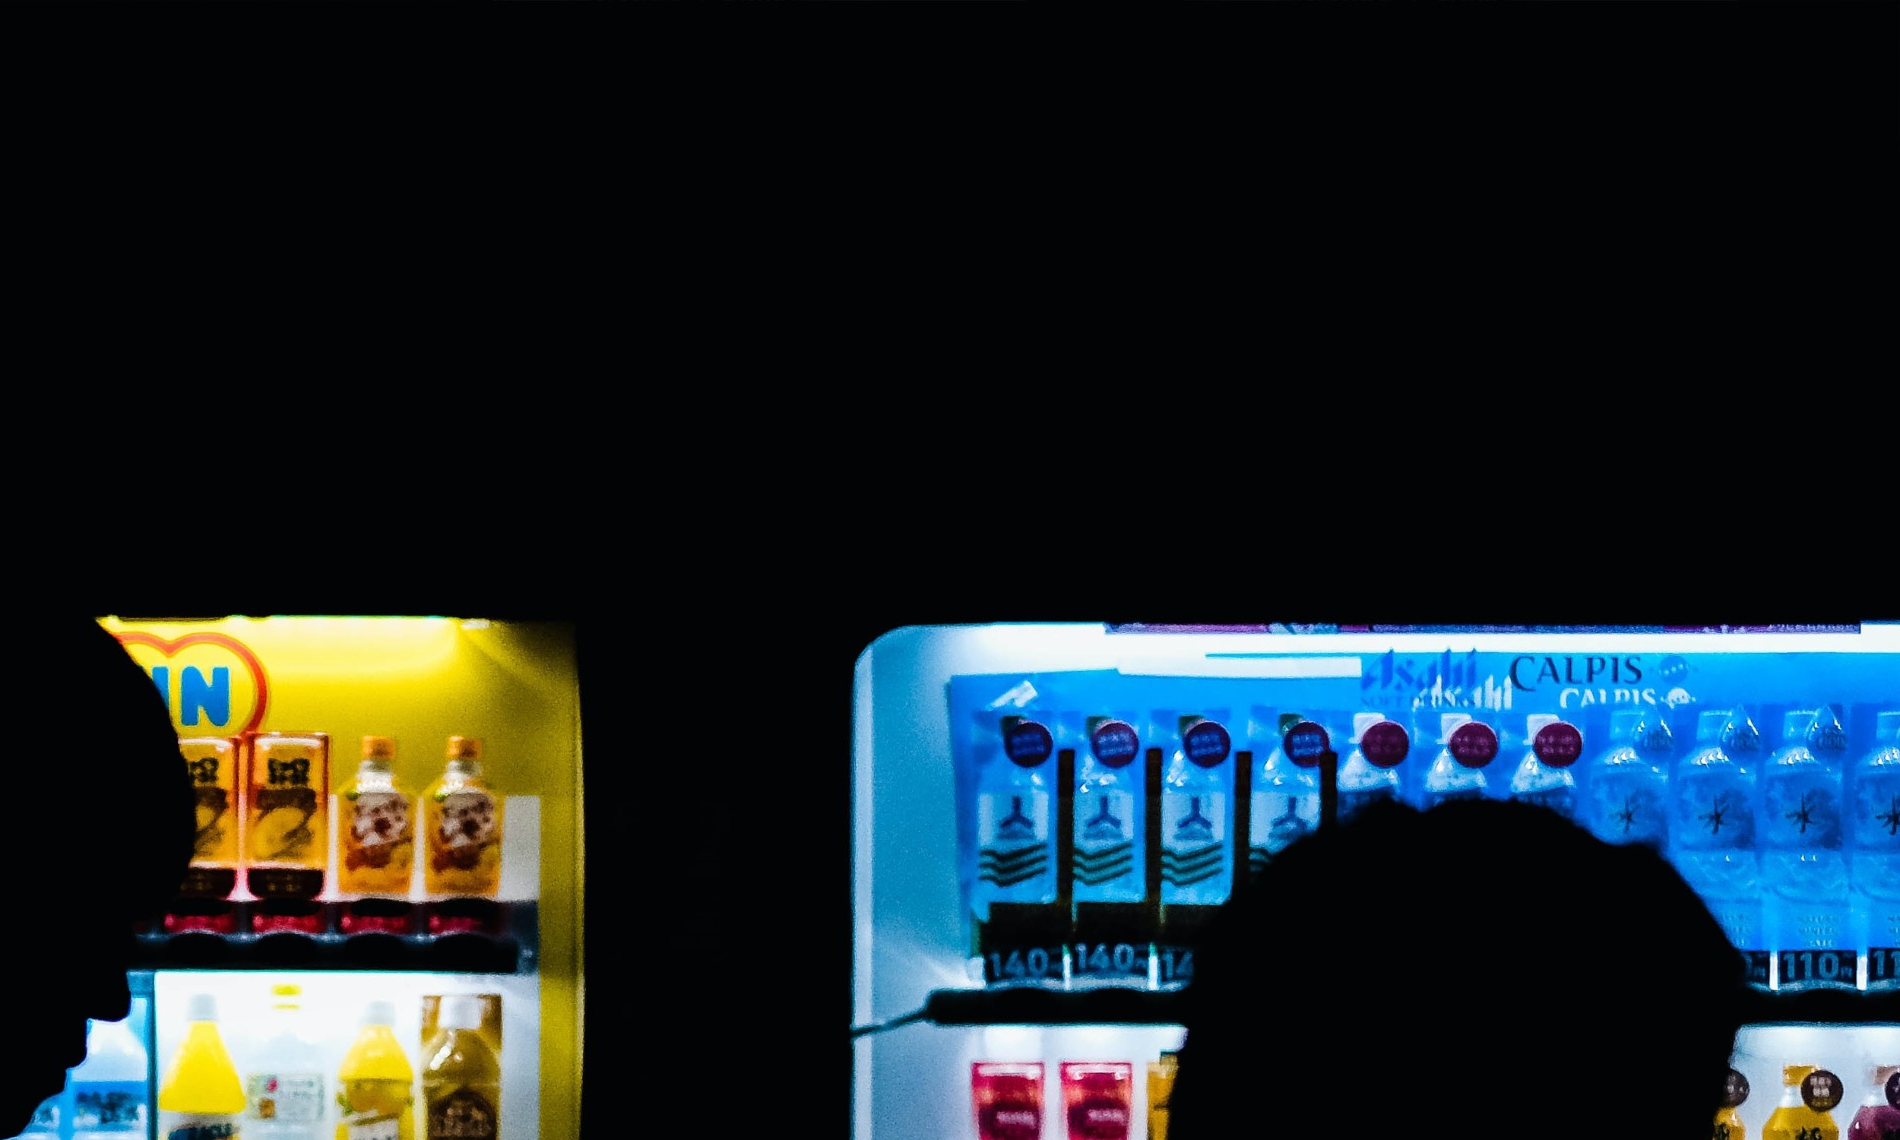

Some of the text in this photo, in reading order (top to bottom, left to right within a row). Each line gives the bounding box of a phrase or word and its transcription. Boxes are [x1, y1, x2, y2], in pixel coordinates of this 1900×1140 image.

[1510, 655, 1643, 692] CALPIS
[989, 948, 1049, 977] 140
[1075, 942, 1135, 972] 140
[1162, 951, 1193, 979] 14
[1783, 952, 1839, 980] 110
[1873, 949, 1900, 978] 11
